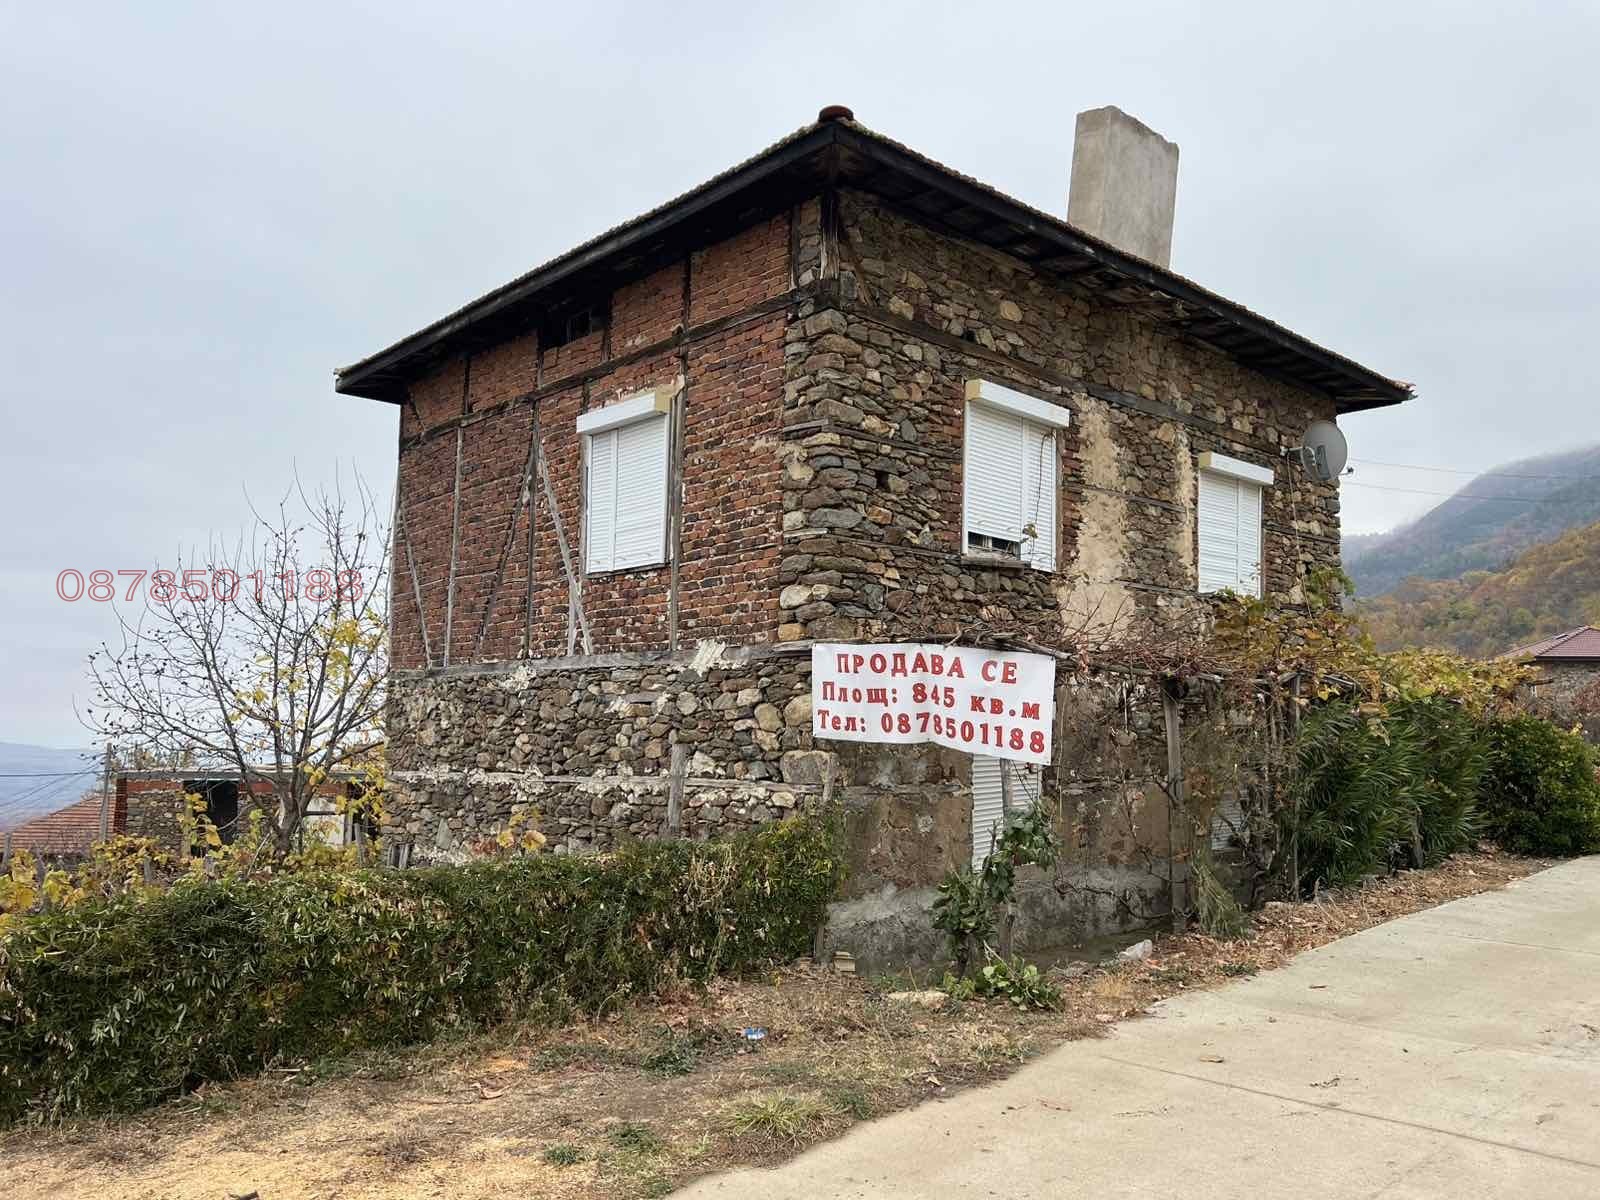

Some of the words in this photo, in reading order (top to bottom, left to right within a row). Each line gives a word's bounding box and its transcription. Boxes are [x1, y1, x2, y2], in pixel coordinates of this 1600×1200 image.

[836, 652, 965, 679] ПРОДАВА
[981, 660, 1018, 684] СЕ
[822, 681, 898, 707] Площ:
[912, 683, 955, 708] 845
[970, 695, 1041, 720] кв.м
[817, 709, 867, 733] Тел:
[880, 712, 1046, 754] 0878501188
